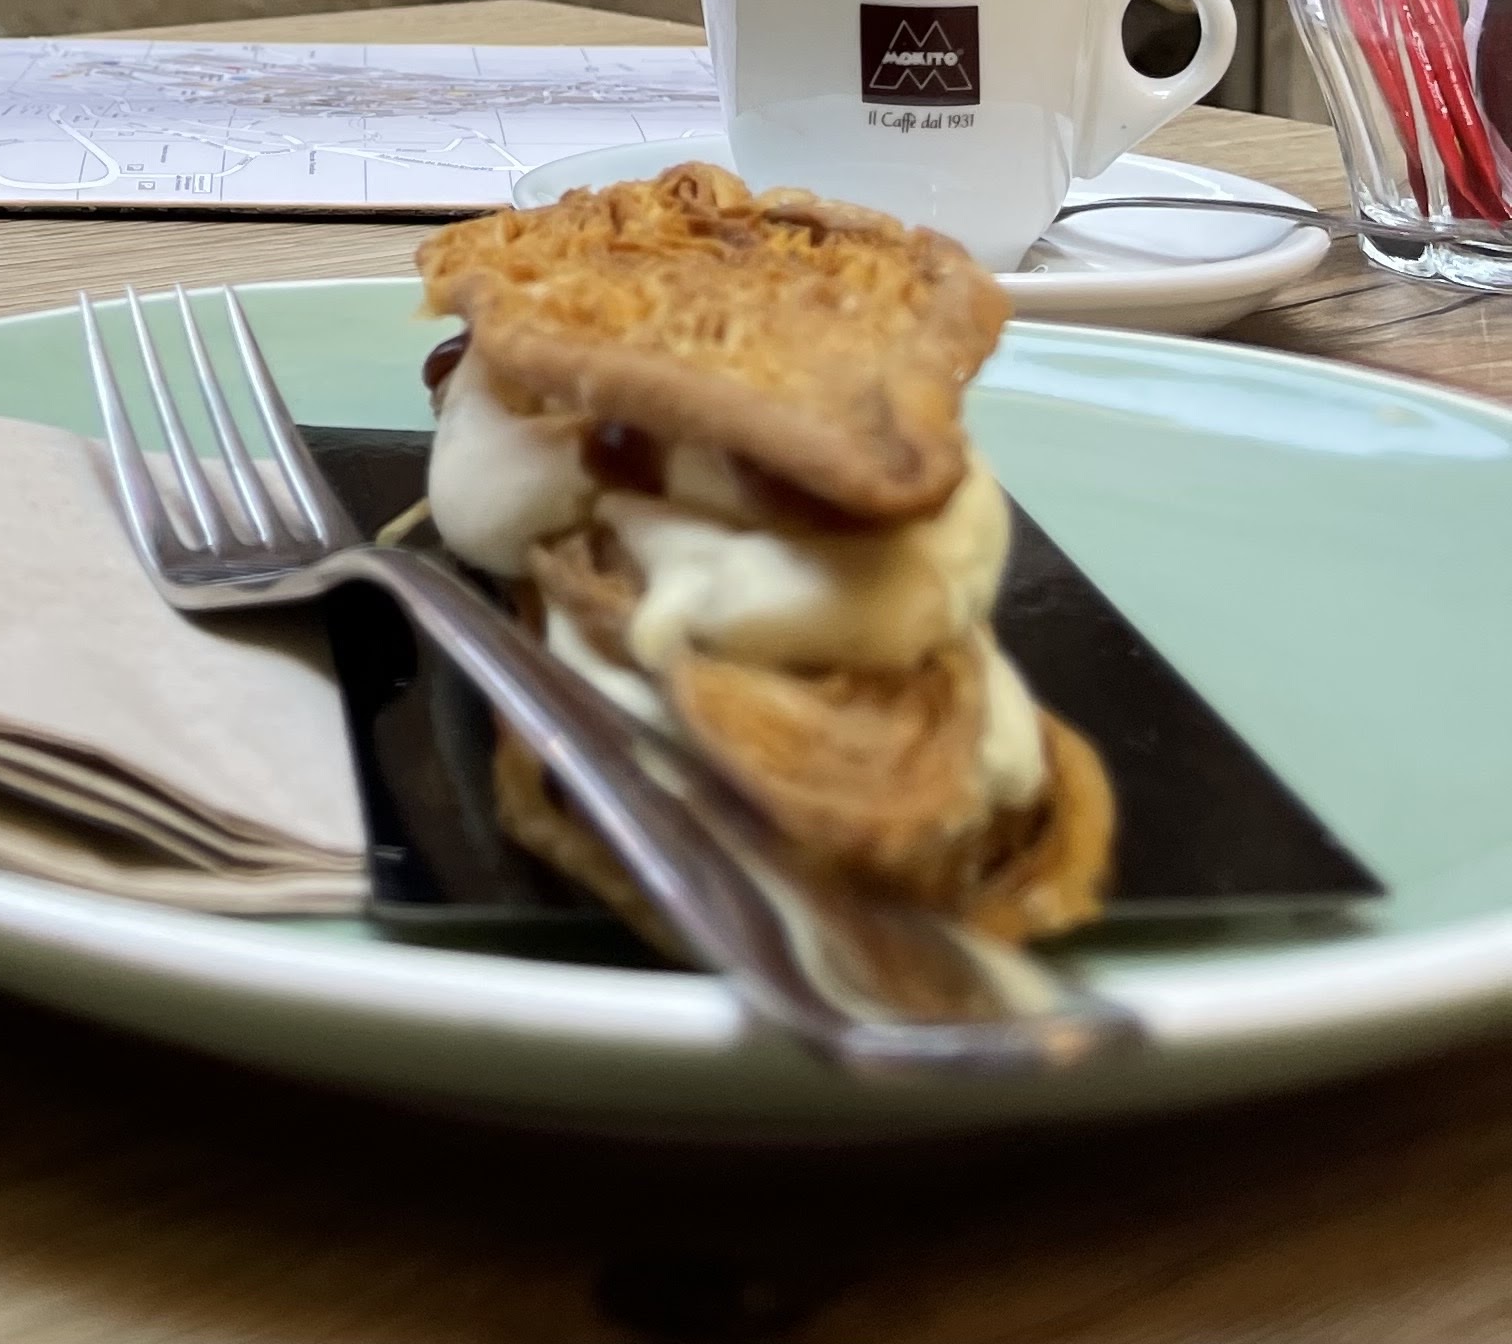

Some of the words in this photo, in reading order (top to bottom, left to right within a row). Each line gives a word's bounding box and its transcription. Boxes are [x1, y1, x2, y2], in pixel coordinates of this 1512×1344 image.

[882, 51, 958, 66] MOKITO
[868, 110, 877, 126] Il
[921, 113, 943, 129] dal
[947, 113, 975, 129] 1931
